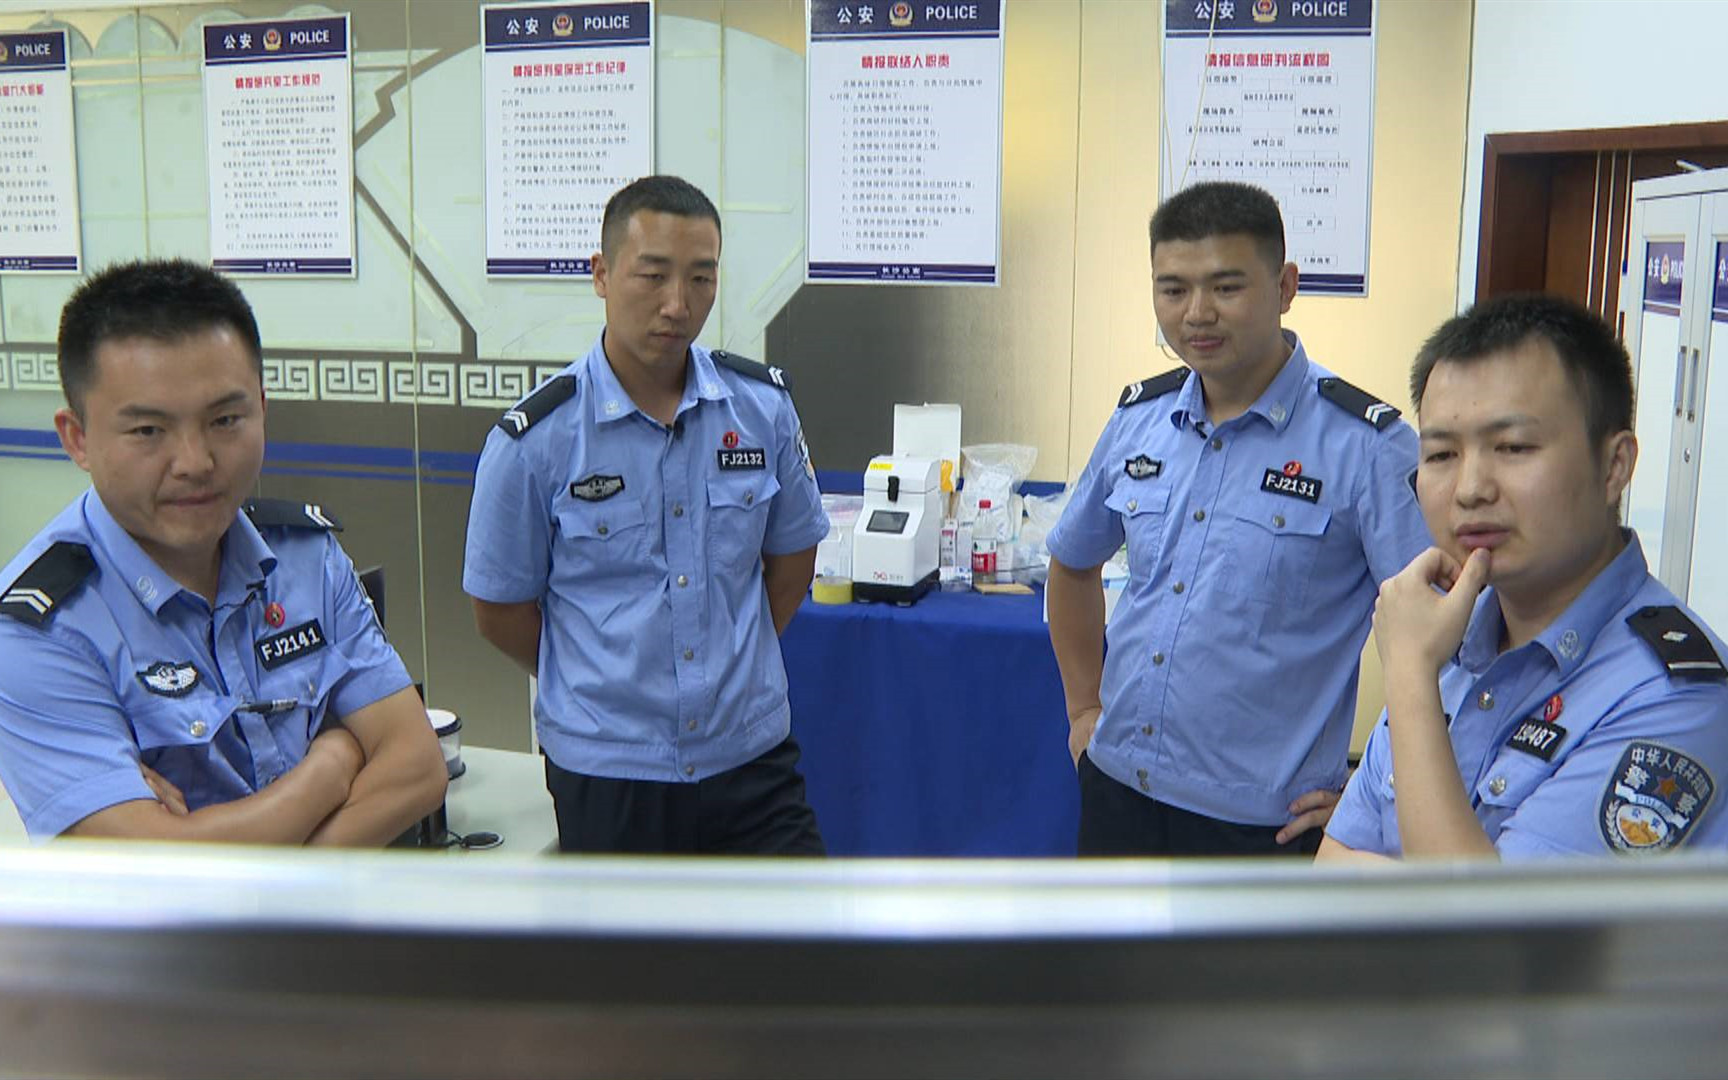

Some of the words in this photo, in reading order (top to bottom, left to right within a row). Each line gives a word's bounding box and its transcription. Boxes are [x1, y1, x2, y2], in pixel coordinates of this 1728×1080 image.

[836, 5, 874, 25] 公安
[925, 5, 977, 20] POLICE
[1194, 1, 1235, 20] 公安
[1291, 1, 1347, 17] POLICE
[506, 17, 539, 35] 公安
[584, 15, 630, 31] POLICE
[223, 32, 252, 50] 公安
[289, 29, 330, 45] POLICE
[15, 43, 51, 57] POLICE
[861, 54, 950, 69] 情报联络人职责
[721, 453, 763, 466] FJ2132
[1265, 473, 1316, 497] FJ2131
[260, 627, 321, 661] FJ2141
